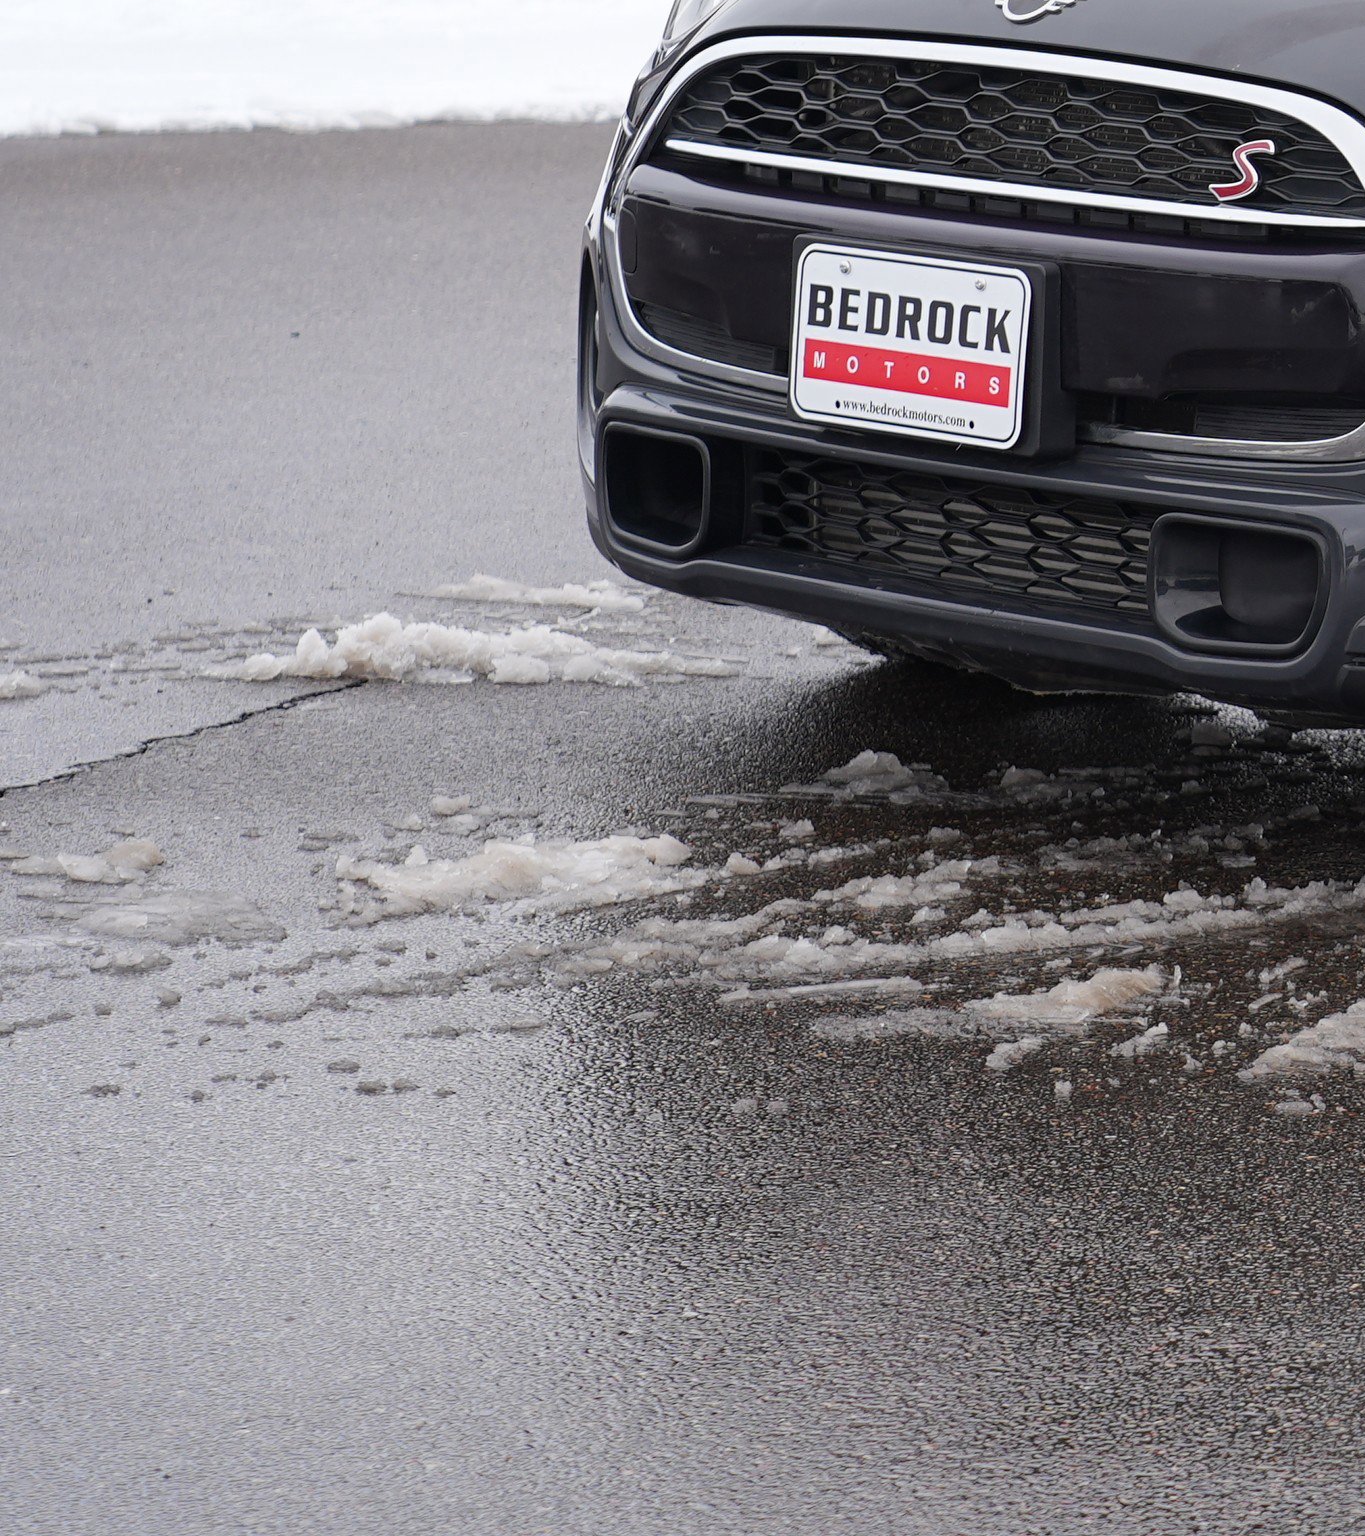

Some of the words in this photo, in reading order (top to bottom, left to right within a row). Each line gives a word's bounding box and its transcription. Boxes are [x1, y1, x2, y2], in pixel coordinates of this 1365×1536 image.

[1208, 139, 1275, 202] S
[807, 283, 1012, 354] BEDROCK
[813, 350, 1001, 396] MOTORS
[842, 398, 967, 428] www.bedrockmotors.com
